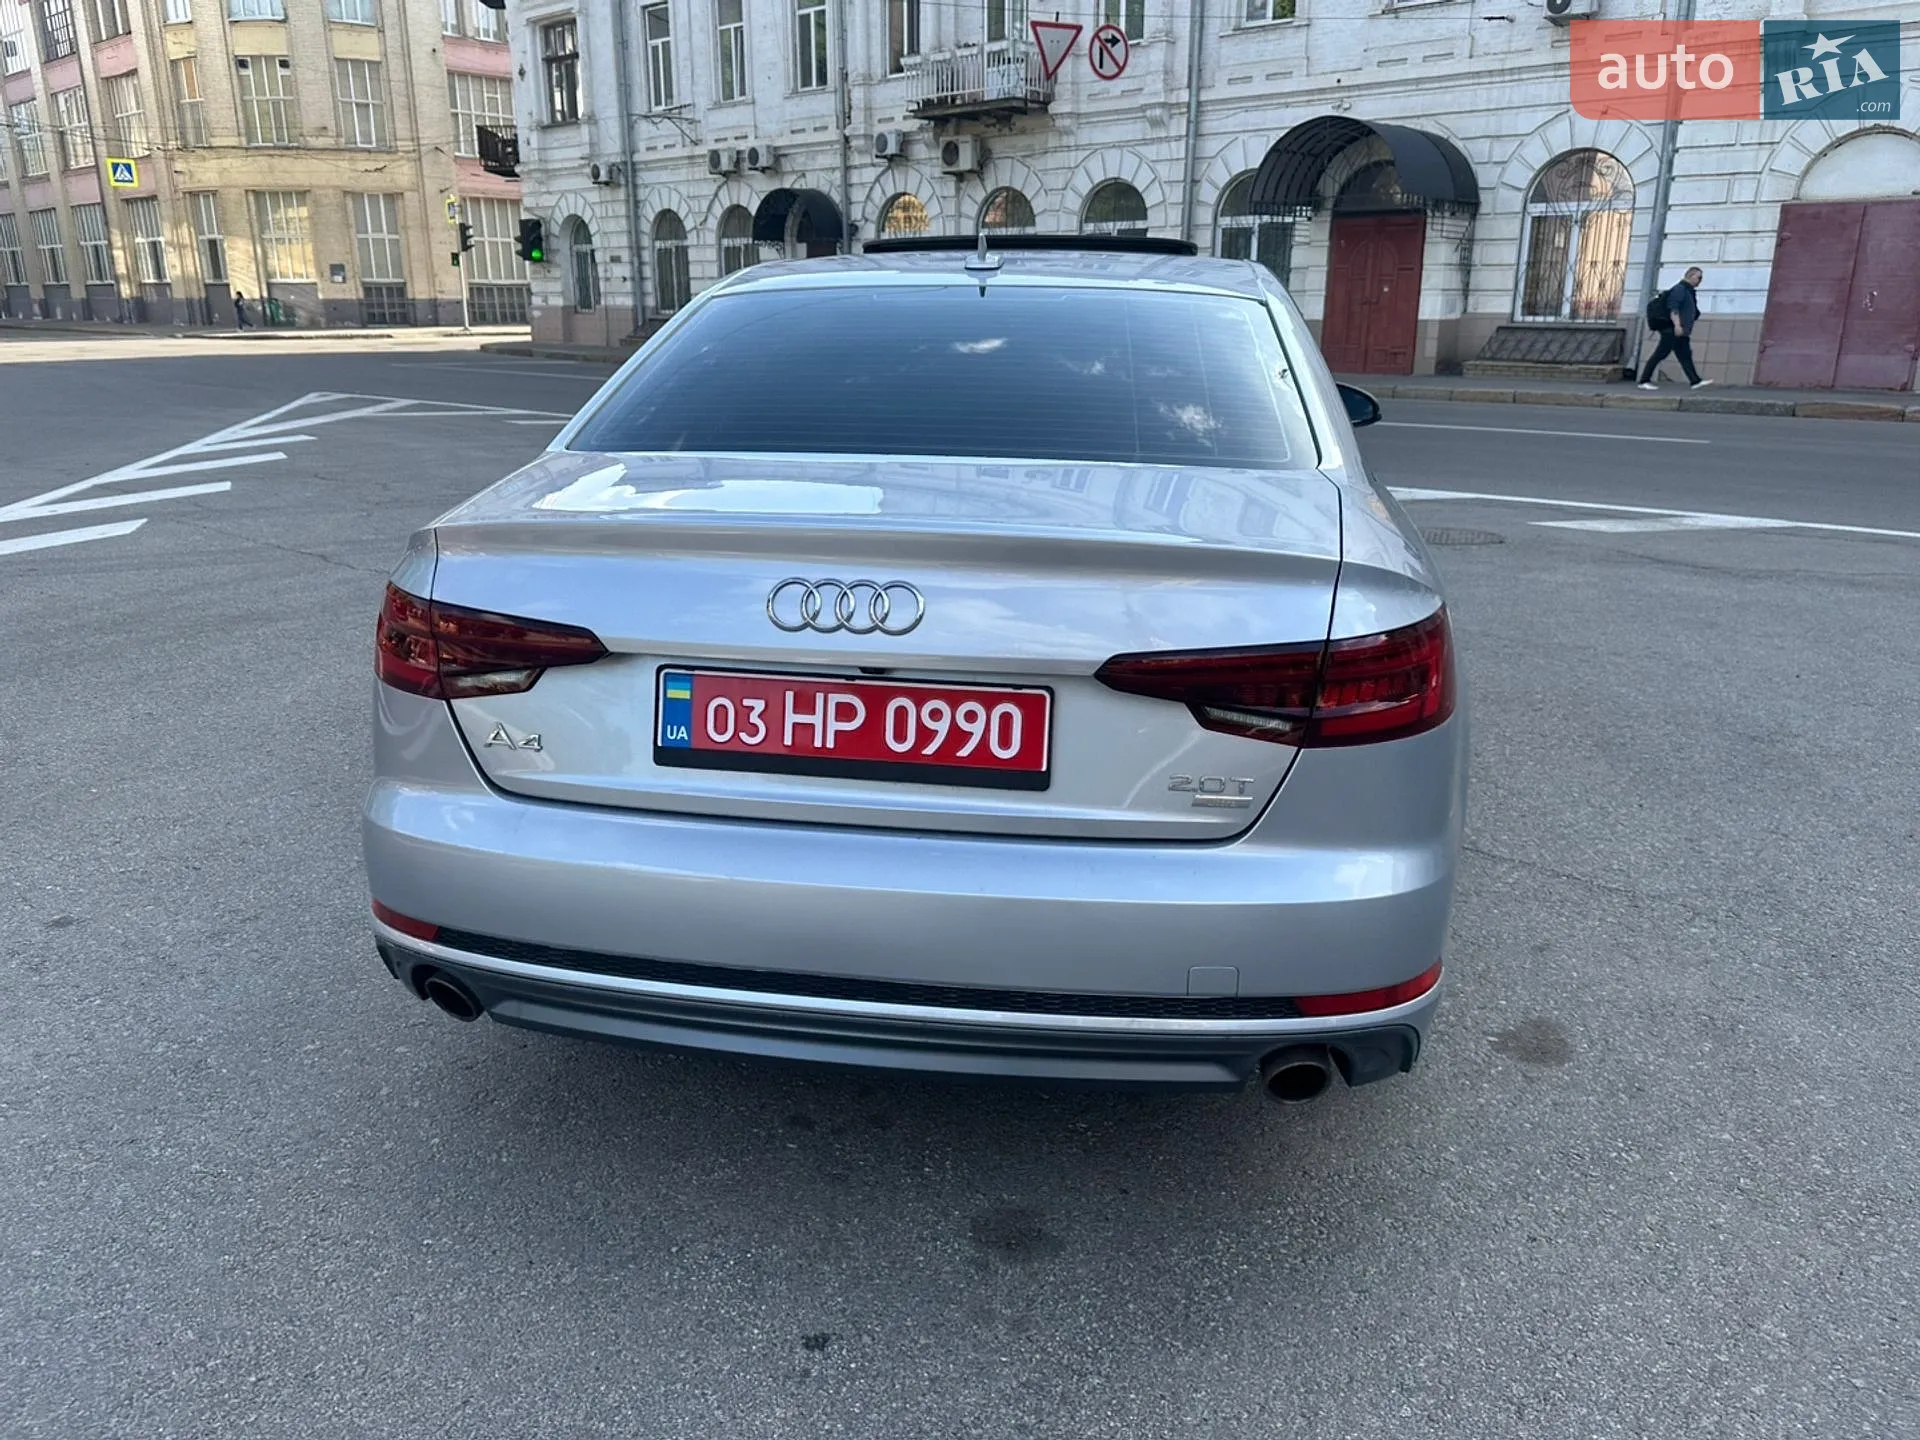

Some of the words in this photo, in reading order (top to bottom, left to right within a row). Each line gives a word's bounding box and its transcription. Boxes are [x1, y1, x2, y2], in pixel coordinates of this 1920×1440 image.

[484, 722, 543, 752] A4
[666, 725, 689, 741] UA
[706, 696, 768, 746] 03
[783, 690, 867, 749] HP
[884, 697, 1024, 760] 0990
